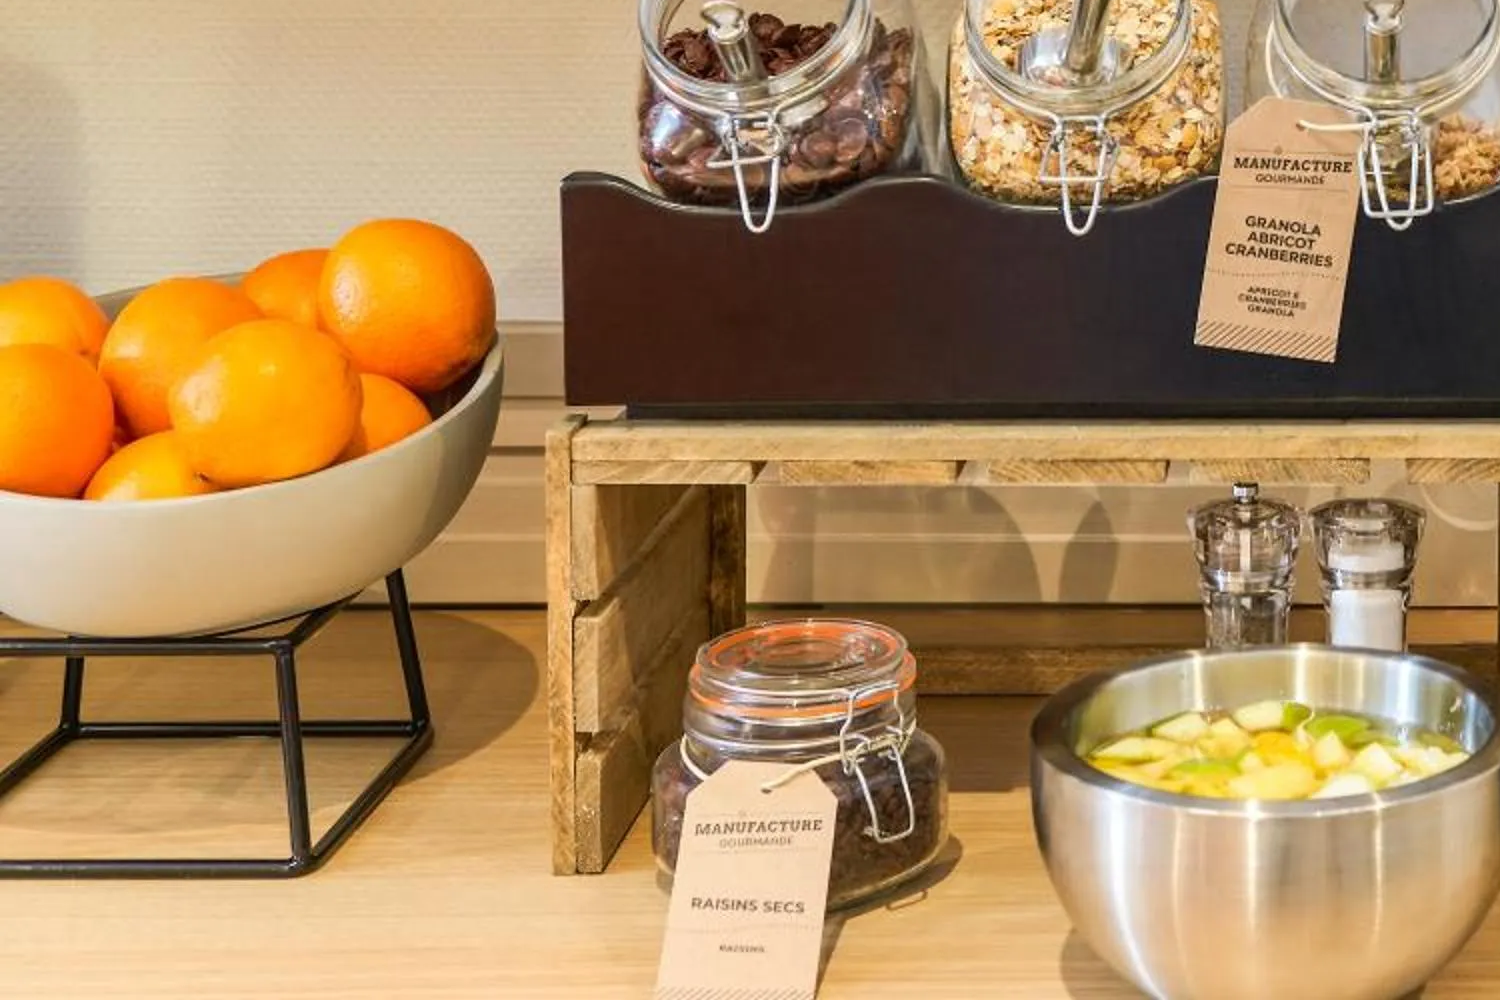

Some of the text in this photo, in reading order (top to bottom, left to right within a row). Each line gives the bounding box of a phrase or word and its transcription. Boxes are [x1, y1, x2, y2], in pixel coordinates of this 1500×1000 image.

[1234, 157, 1353, 172] MANUFACTURE
[1255, 173, 1325, 185] GOURMANDE
[1245, 216, 1321, 236] GRANOLA
[1247, 231, 1316, 251] ABRICOT
[1225, 243, 1333, 268] CRANBERRIES
[1247, 286, 1291, 298] APRICOT
[1238, 293, 1307, 310] CRANBERRIES
[1247, 305, 1295, 318] GRANOLA
[695, 819, 823, 836] MANUFACTURE
[719, 836, 793, 848] GOURMANDE
[691, 897, 805, 914] RAISINS SECS
[719, 945, 765, 953] RAISINS
